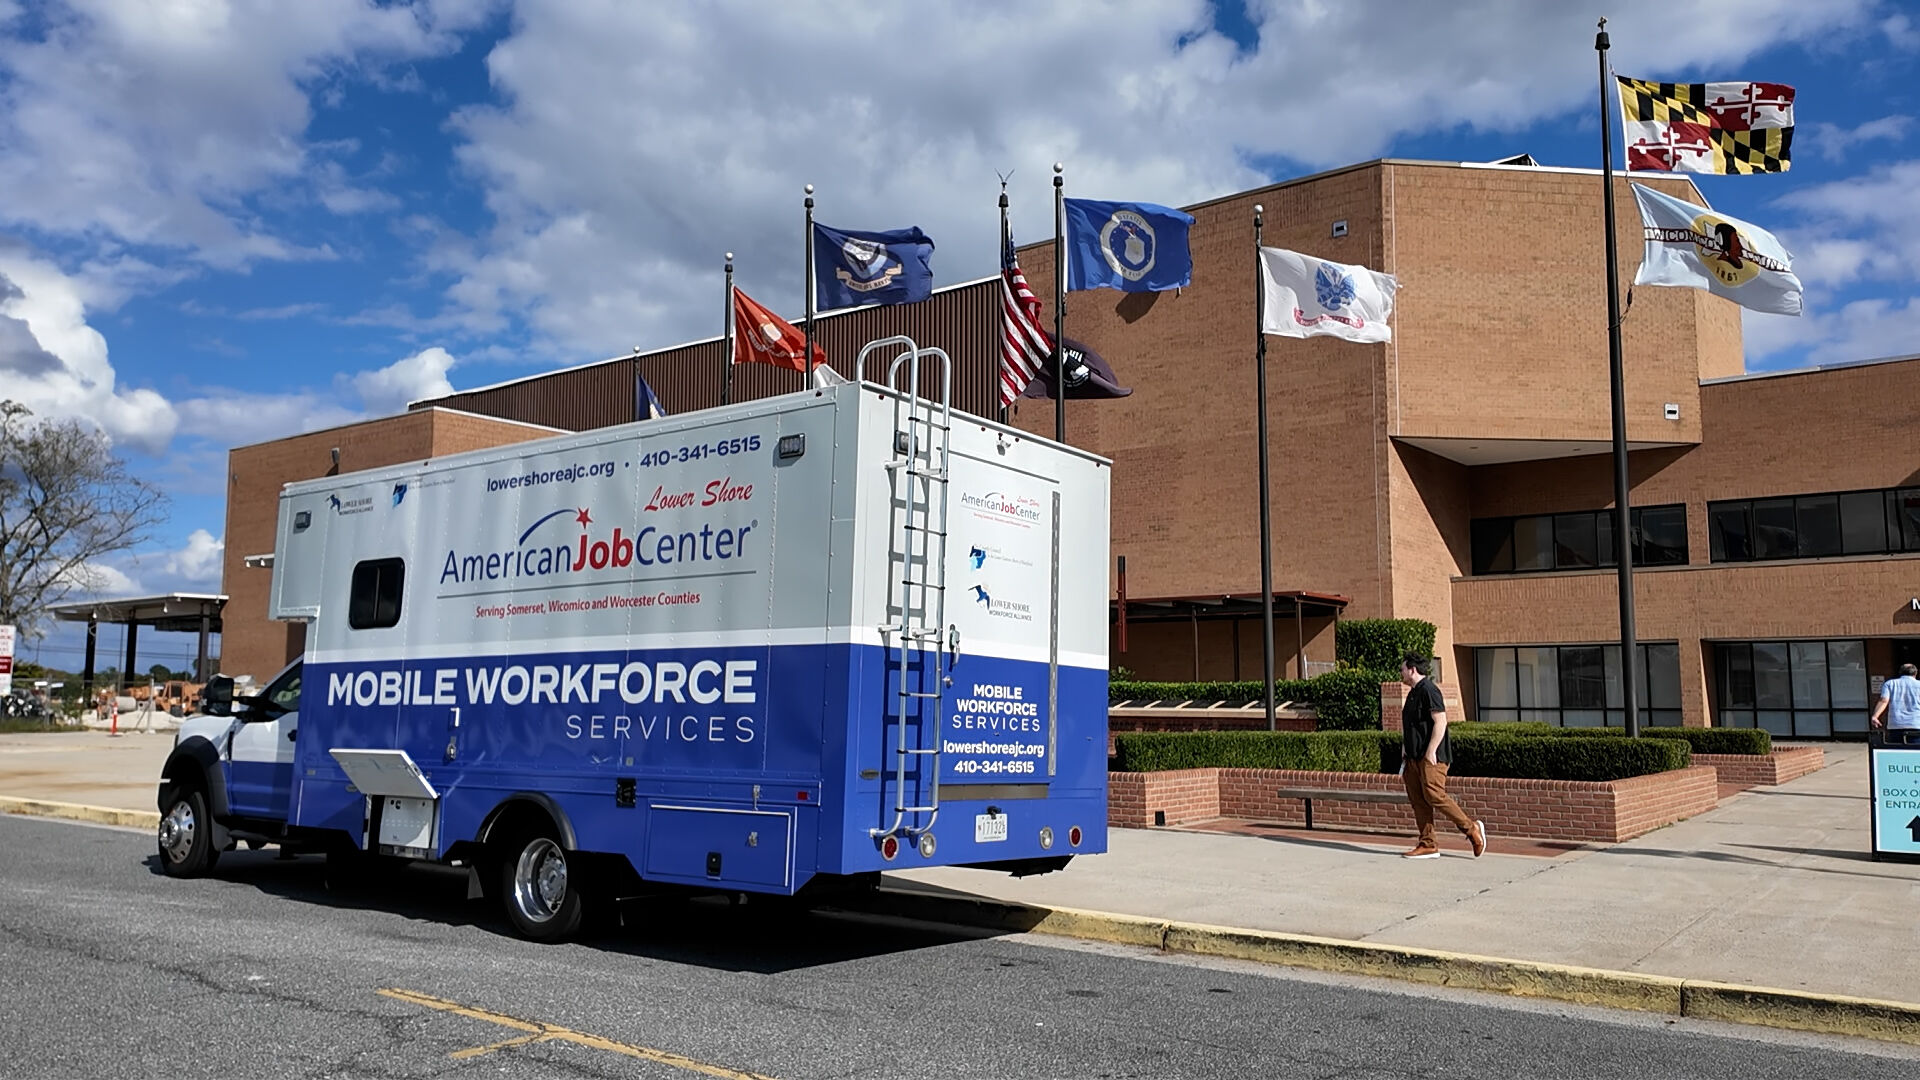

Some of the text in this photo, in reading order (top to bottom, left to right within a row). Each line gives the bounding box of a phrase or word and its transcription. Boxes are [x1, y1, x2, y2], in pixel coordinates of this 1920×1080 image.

[487, 435, 761, 492] lowershoreajc.org 410-341-6515
[644, 476, 753, 512] Lower Shore
[476, 592, 701, 619] Serving Somerset, Wicomico and Worcester Counties
[991, 599, 1012, 610] LOWER
[327, 660, 758, 707] MOBILE WORKFORCE
[973, 684, 1023, 700] MOBILE
[956, 699, 1037, 716] WORKFORCE
[565, 714, 755, 743] SERVICES
[952, 715, 1040, 732] SERVICES
[943, 740, 1045, 757] lowershoreajc.org
[954, 760, 1035, 774] 410-341-6515
[1882, 788, 1920, 798] BOX O
